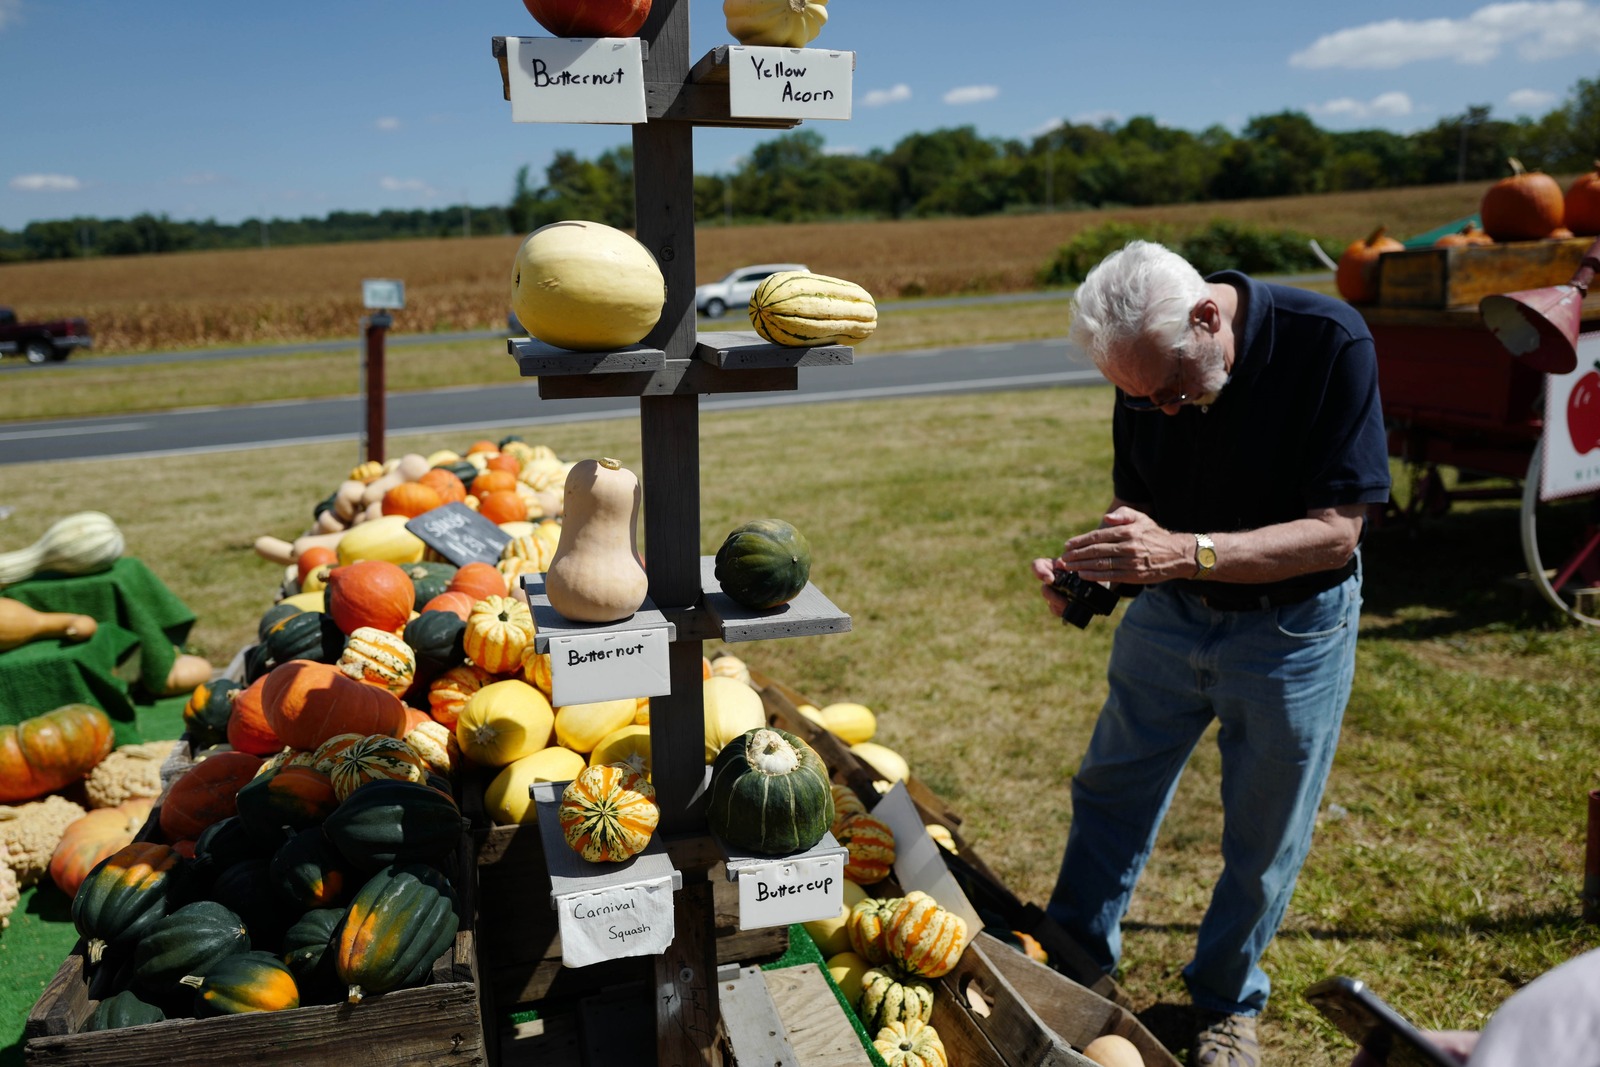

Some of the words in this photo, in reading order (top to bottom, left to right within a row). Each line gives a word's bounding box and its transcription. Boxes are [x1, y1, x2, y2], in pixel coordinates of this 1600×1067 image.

[532, 58, 625, 88] Butternut
[750, 55, 807, 80] Yellow
[781, 80, 834, 102] Acorn
[567, 643, 644, 666] Butternut
[755, 877, 833, 902] Buttercup
[573, 898, 635, 920] Carnival
[608, 923, 651, 943] Squash
